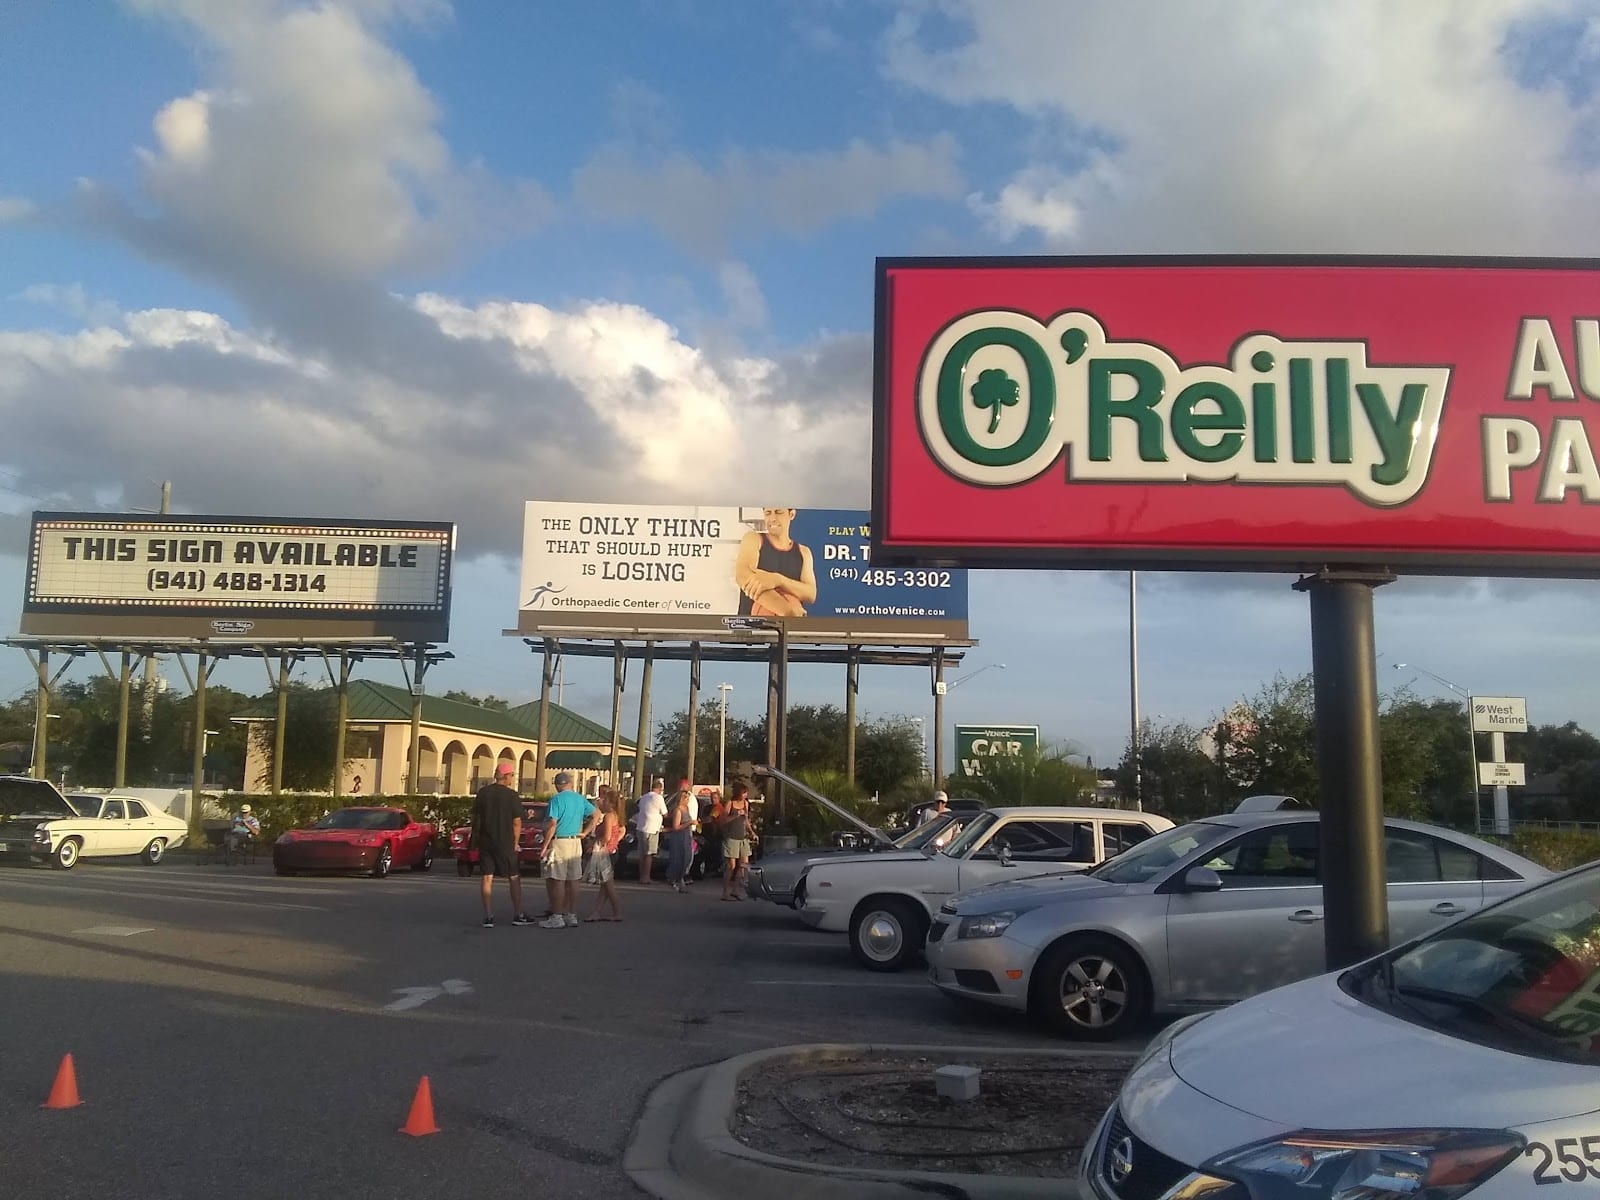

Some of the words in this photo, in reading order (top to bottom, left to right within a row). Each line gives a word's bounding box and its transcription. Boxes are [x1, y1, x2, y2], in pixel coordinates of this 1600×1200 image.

[934, 322, 1430, 486] O'Reilly
[542, 518, 571, 531] THE
[579, 516, 639, 536] ONLY
[647, 518, 721, 538] THING
[829, 526, 855, 537] PLAY
[63, 537, 136, 562] THIS
[234, 541, 418, 568] AVAILABLE
[546, 540, 590, 554] THAT
[596, 541, 661, 556] SHOULD
[667, 543, 713, 557] HURT
[824, 545, 857, 561] DR.
[147, 568, 206, 592] (941)
[213, 572, 326, 593] 488-1314
[582, 563, 596, 576] IS
[601, 561, 685, 582] LOSING
[829, 567, 859, 580] (941)
[861, 570, 951, 588] 485-3302
[551, 597, 620, 609] Orthopaedic
[623, 598, 660, 608] Center
[661, 599, 673, 611] of
[675, 599, 711, 610] Venice
[1486, 704, 1513, 714] West
[1489, 714, 1525, 725] Marine
[984, 729, 1011, 738] VENICE
[971, 738, 1024, 757] CAR
